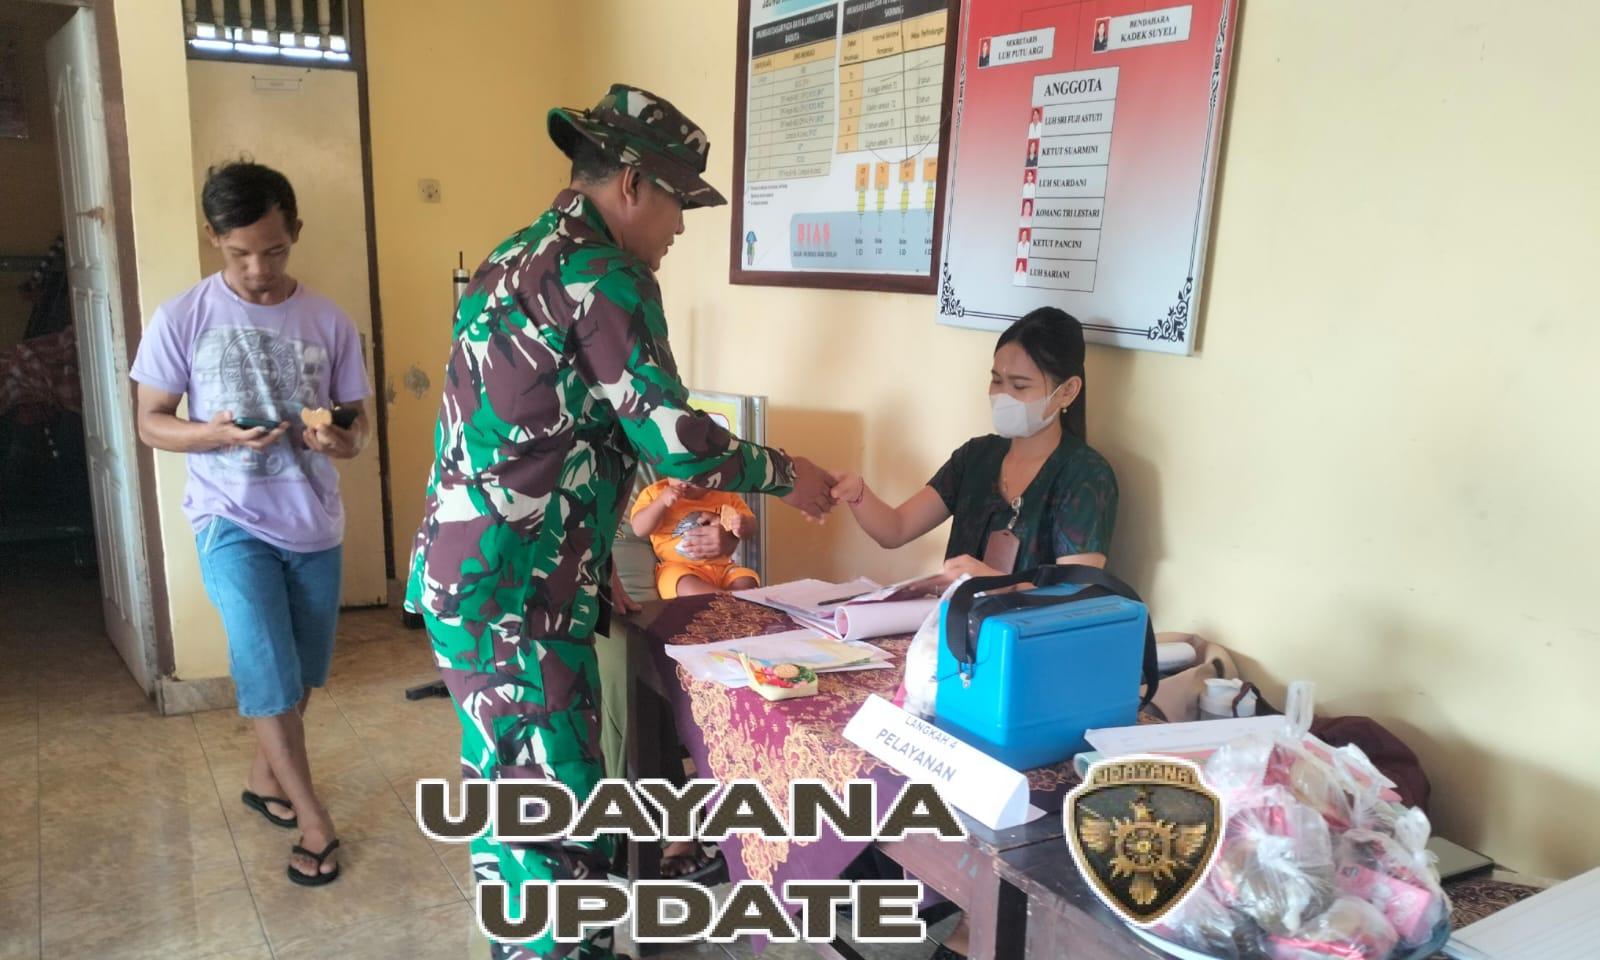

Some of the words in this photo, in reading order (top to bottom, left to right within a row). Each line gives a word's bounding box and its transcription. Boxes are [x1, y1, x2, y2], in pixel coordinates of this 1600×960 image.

[1130, 16, 1170, 28] BENDAHARA
[1120, 31, 1147, 43] KADEK
[1148, 26, 1177, 39] SUYELI
[1011, 48, 1027, 58] PUTU
[1029, 46, 1044, 55] ARGI
[1043, 78, 1102, 97] ANGGOTA
[1045, 116, 1057, 125] LUH
[1057, 115, 1067, 124] SRI
[1081, 113, 1103, 123] ASTUTI
[1041, 147, 1063, 156] KETUT
[1064, 145, 1099, 155] SUARMINI
[1039, 179, 1053, 188] LUH
[1053, 178, 1087, 187] SUARDANI
[1035, 209, 1062, 217] KOMANG
[1062, 209, 1073, 217] TRI
[1073, 209, 1100, 218] LESTARI
[1032, 239, 1054, 248] KETUT
[1055, 240, 1082, 249] PANCINI
[1029, 268, 1043, 277] LUH
[1043, 269, 1070, 279] SARIANI
[905, 716, 952, 745] LANGKAH
[950, 741, 958, 749] 4
[876, 728, 957, 782] PELAYANAN
